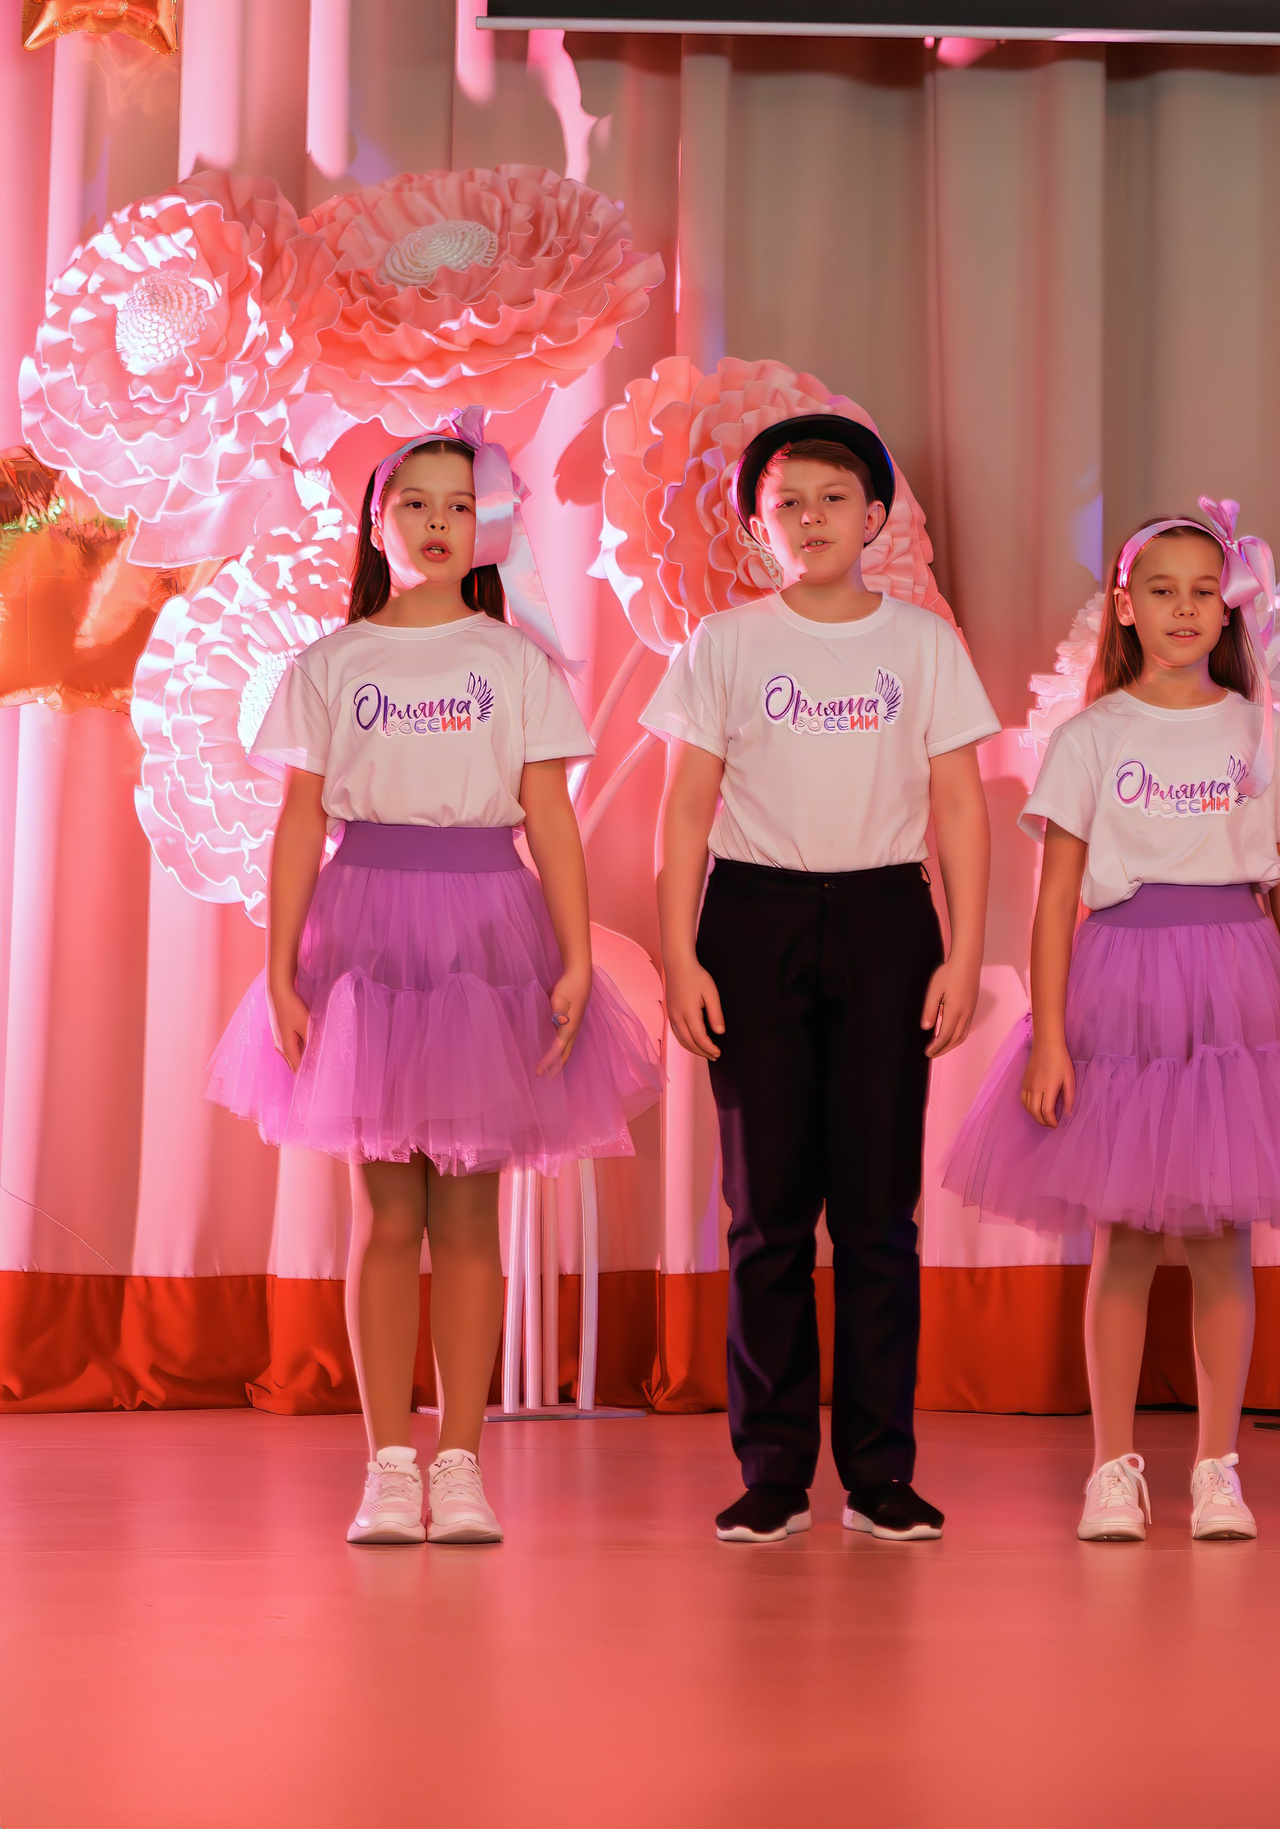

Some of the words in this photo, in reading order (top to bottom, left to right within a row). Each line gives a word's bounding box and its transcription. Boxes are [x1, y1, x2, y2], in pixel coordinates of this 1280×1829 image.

[353, 683, 471, 731] Орлята
[765, 675, 880, 725] Орлята
[1116, 760, 1231, 807] Орлята
